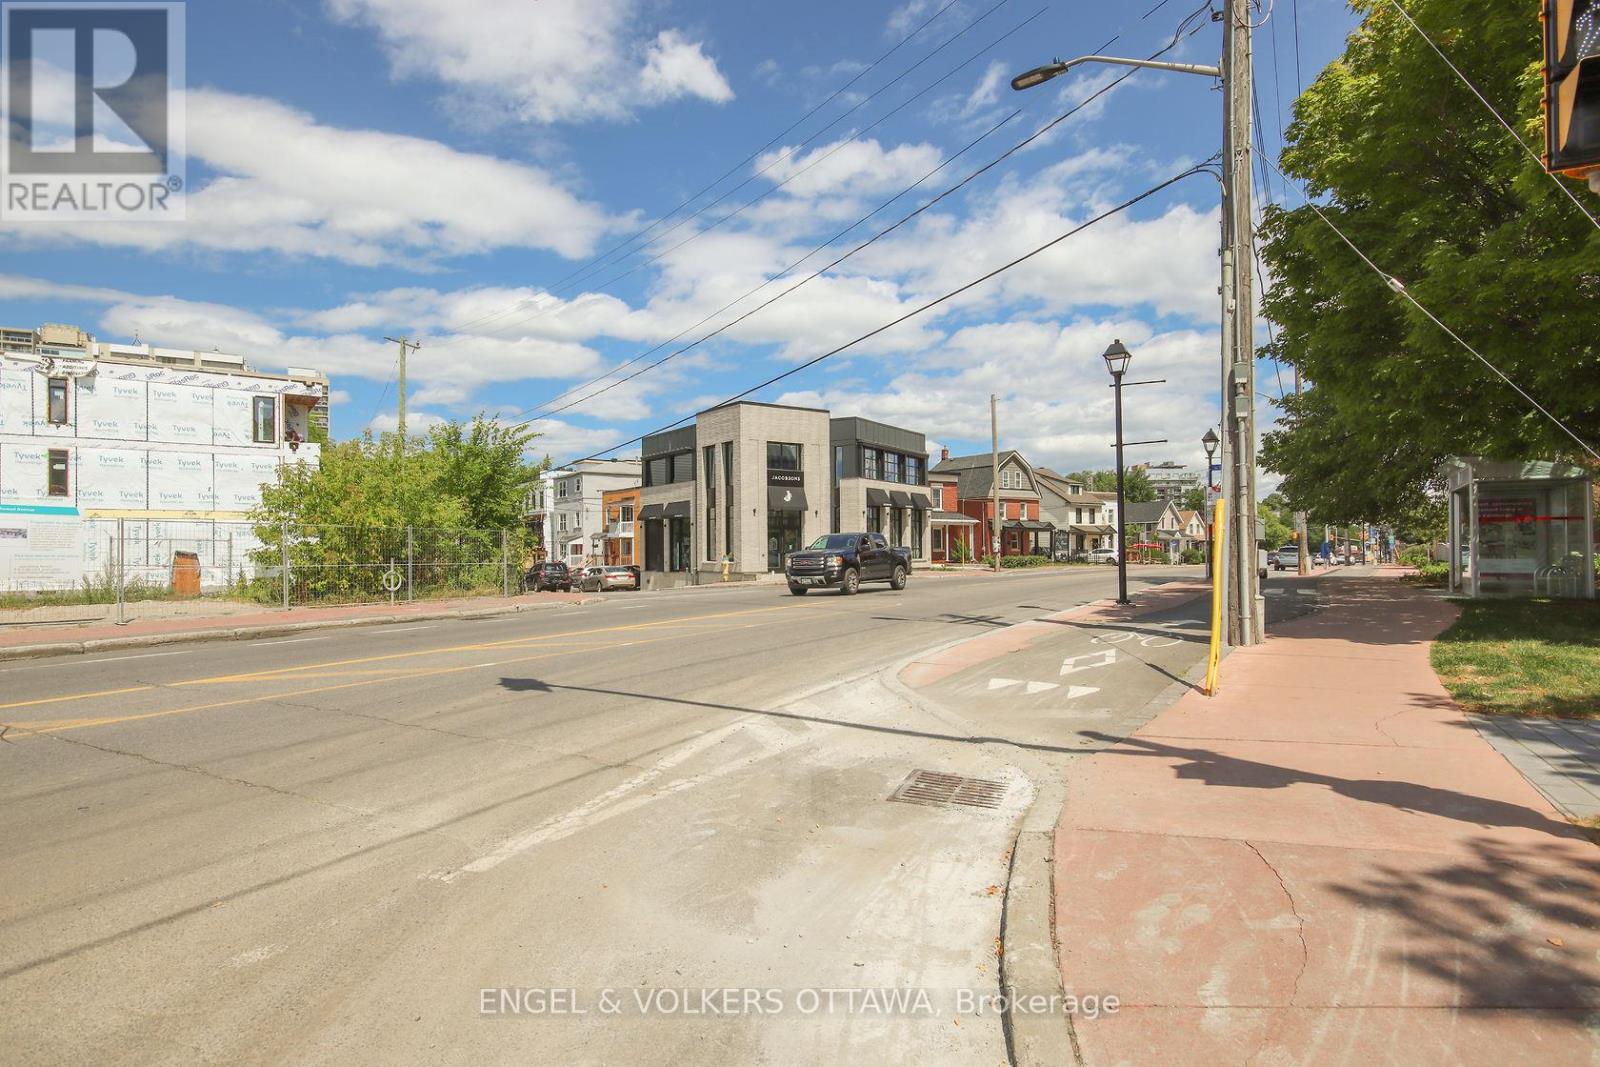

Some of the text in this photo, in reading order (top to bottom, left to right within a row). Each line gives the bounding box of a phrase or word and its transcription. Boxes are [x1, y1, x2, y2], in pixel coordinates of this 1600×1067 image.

[113, 386, 138, 395] Tyvek
[153, 389, 177, 398] Tyvek
[93, 419, 118, 428] Tyvek
[15, 451, 41, 460] Tyvek
[99, 455, 124, 463] Tyvek
[178, 459, 201, 467] Tyvek
[250, 462, 273, 470] Tyvek
[120, 490, 144, 498] Tyvek
